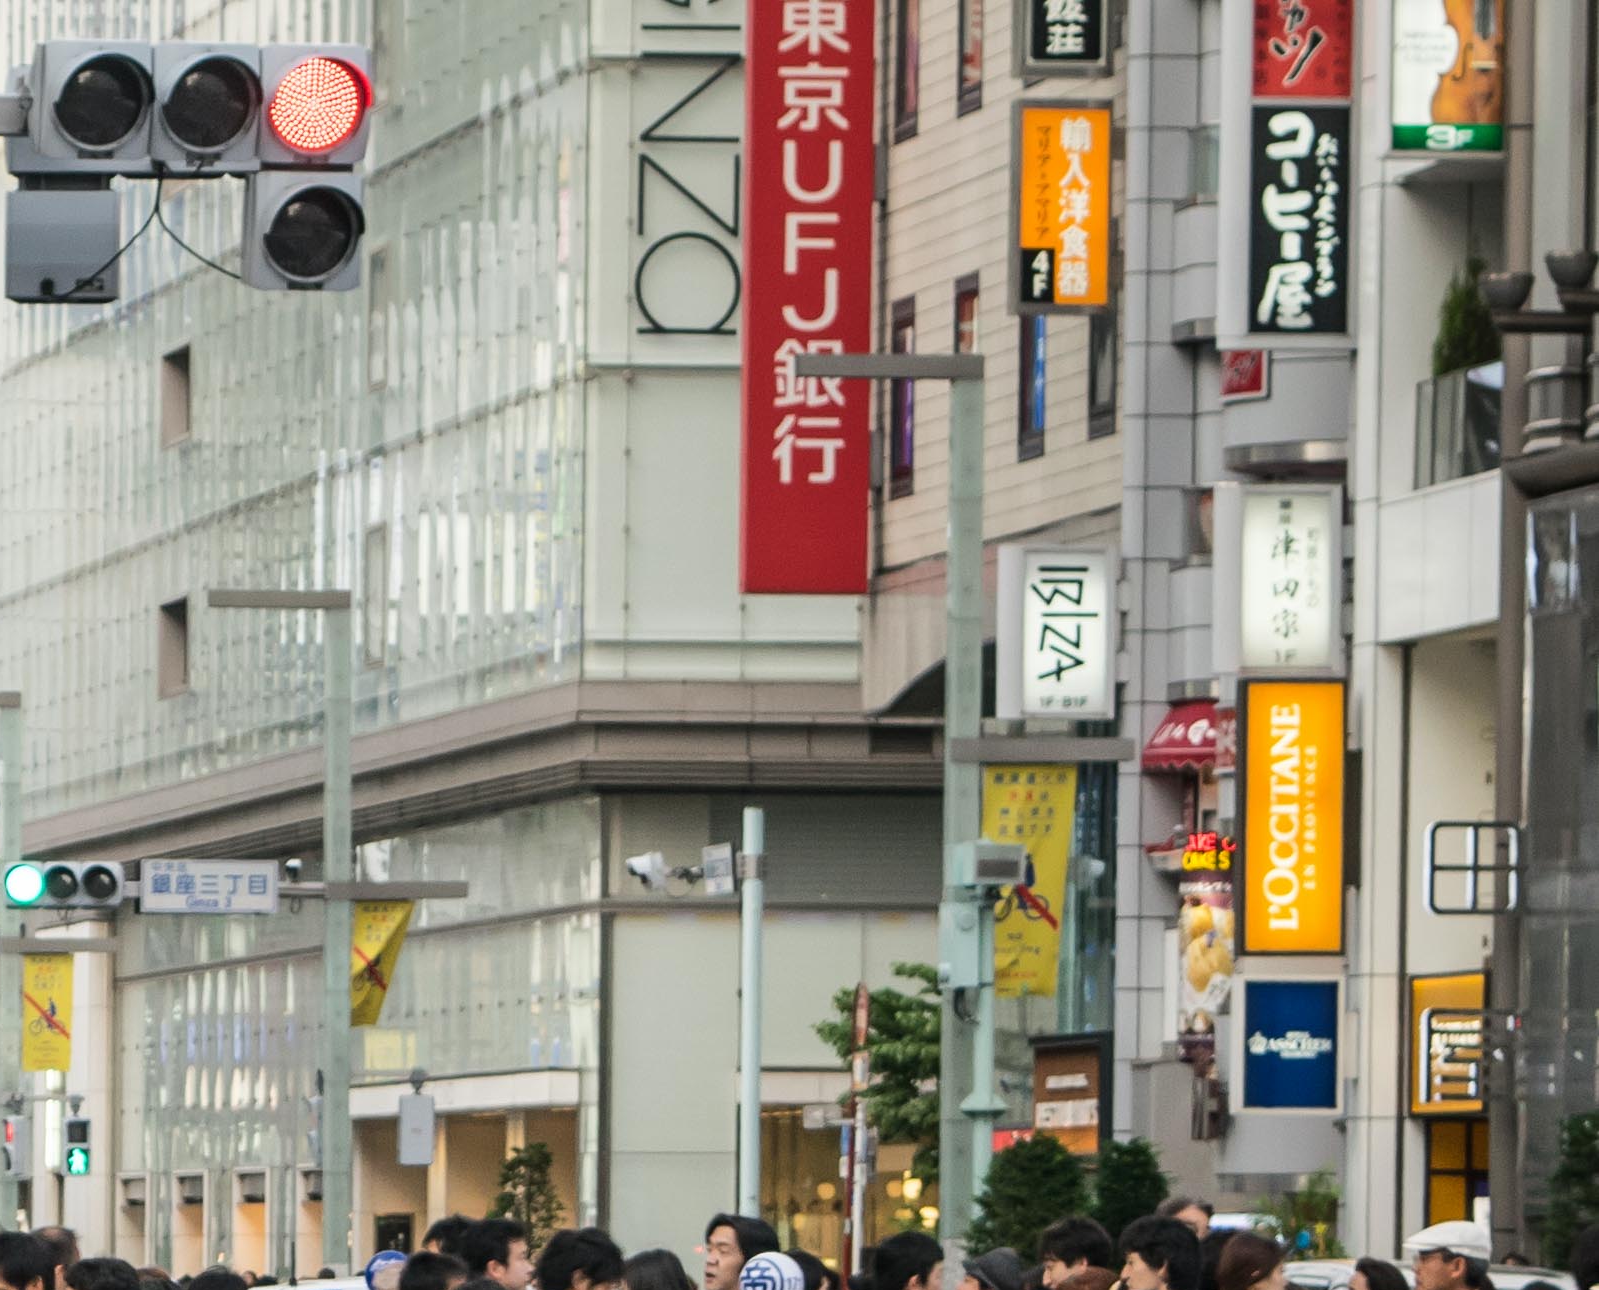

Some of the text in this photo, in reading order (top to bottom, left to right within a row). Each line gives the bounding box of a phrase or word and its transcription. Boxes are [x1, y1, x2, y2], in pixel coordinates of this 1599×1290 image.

[636, 0, 741, 334] INZA
[1059, 116, 1092, 296] 輸入洋食器
[1258, 111, 1315, 328] コーヒー屋
[1426, 125, 1474, 149] 3F
[1032, 251, 1049, 297] 4F
[151, 873, 267, 895] 銀座三丁目
[1262, 704, 1301, 931] L'OCCITANE
